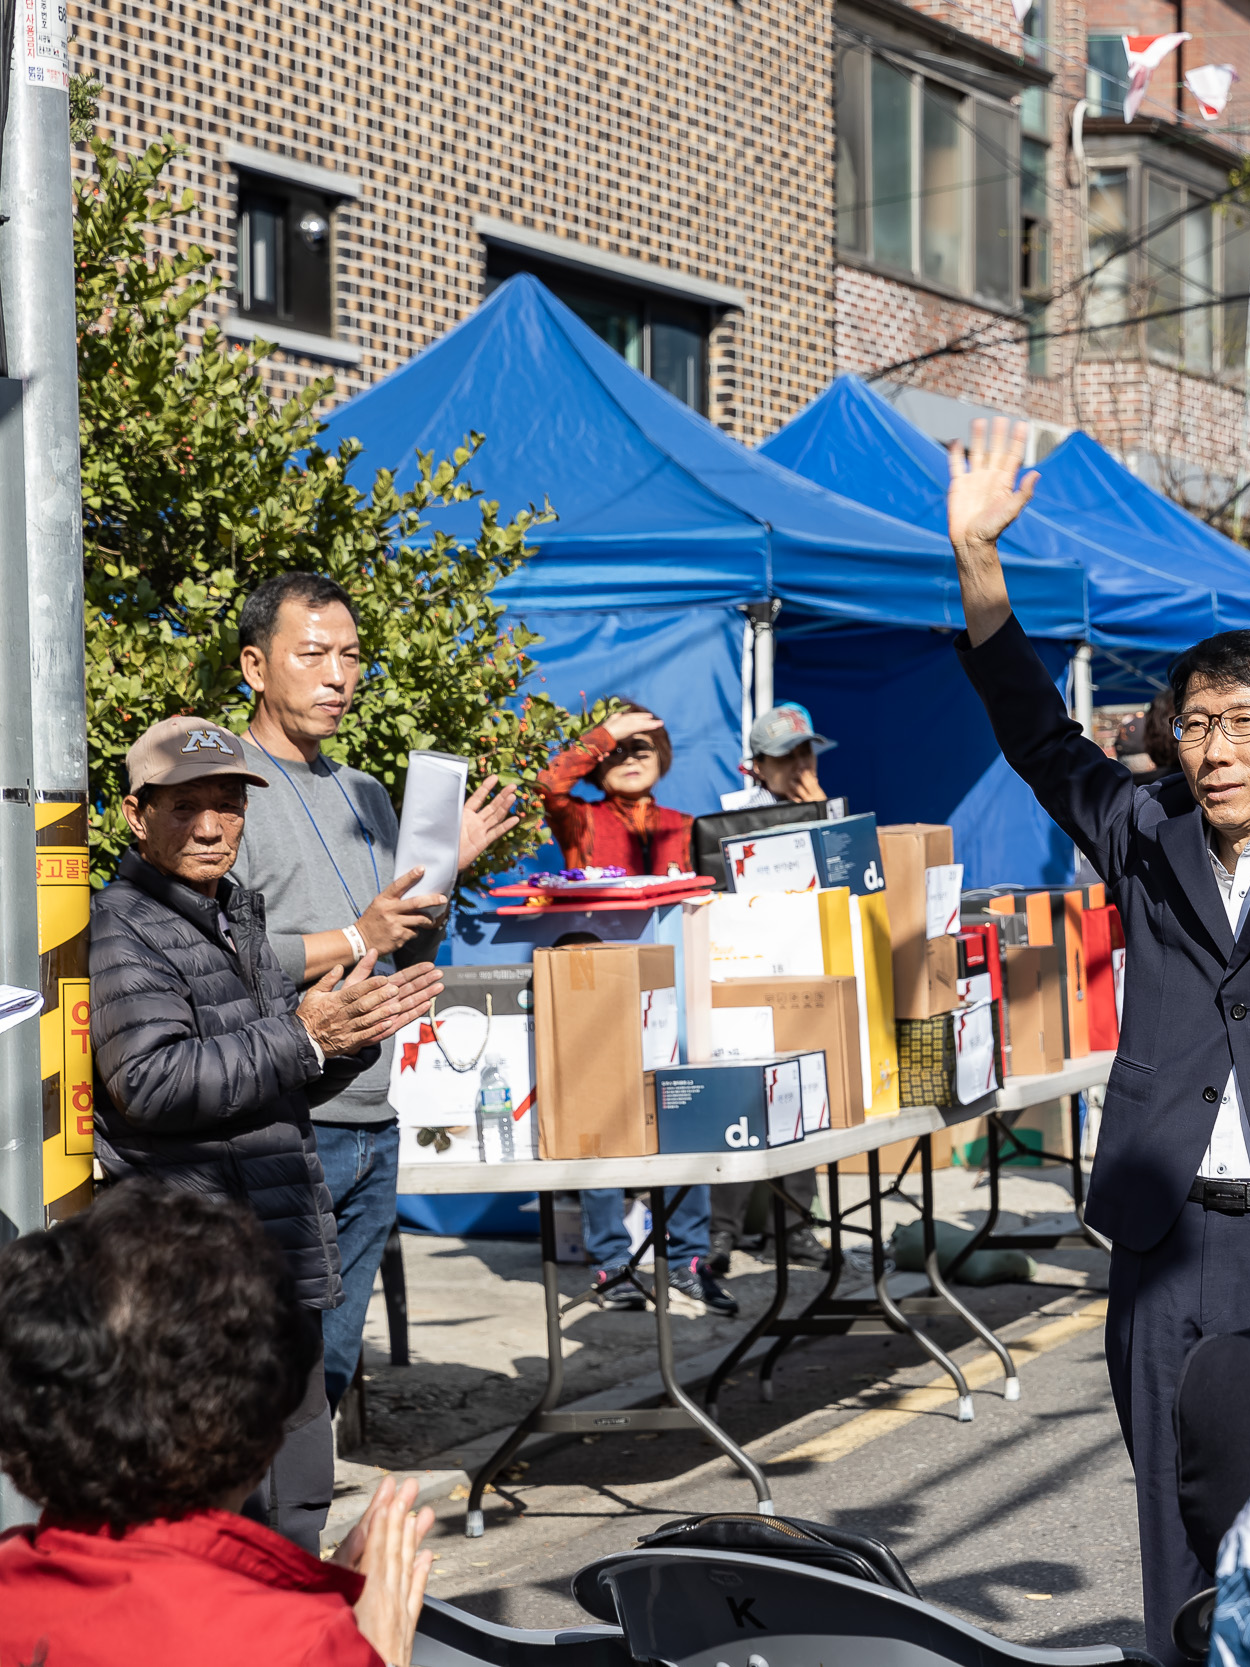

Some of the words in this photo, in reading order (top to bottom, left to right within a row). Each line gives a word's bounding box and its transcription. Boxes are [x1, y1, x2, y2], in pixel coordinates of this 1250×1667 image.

[26, 14, 36, 59] 사용금지
[181, 729, 236, 757] M
[725, 1116, 760, 1148] d.
[726, 1596, 769, 1629] K
